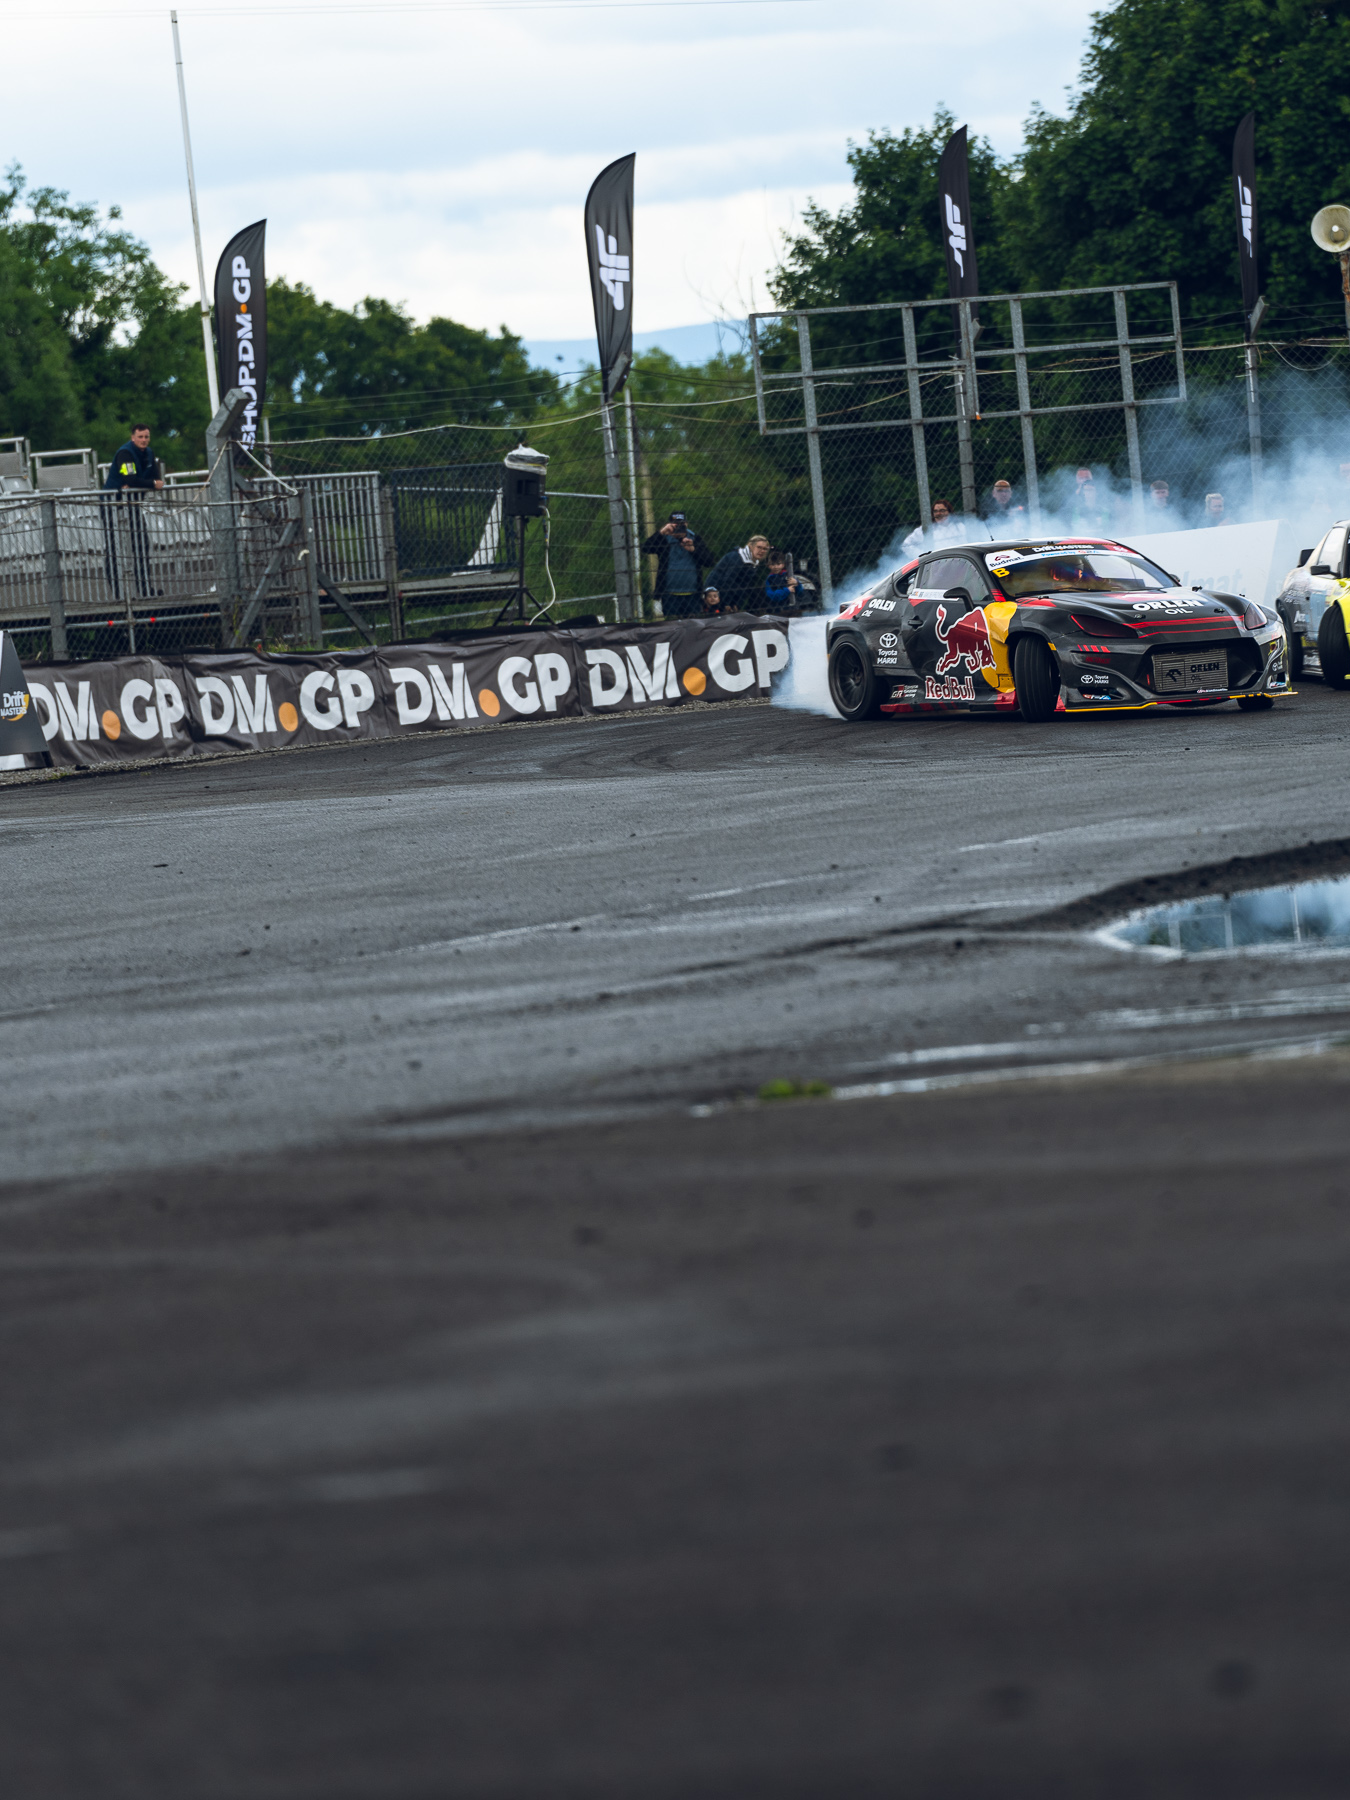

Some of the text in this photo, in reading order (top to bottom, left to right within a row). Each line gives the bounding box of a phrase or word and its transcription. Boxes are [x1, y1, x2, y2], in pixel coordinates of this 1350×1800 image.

[868, 598, 897, 612] ORLEN
[1132, 599, 1204, 611] ORLEN
[925, 675, 976, 700] Red Bull
[3, 690, 26, 708] Drift
